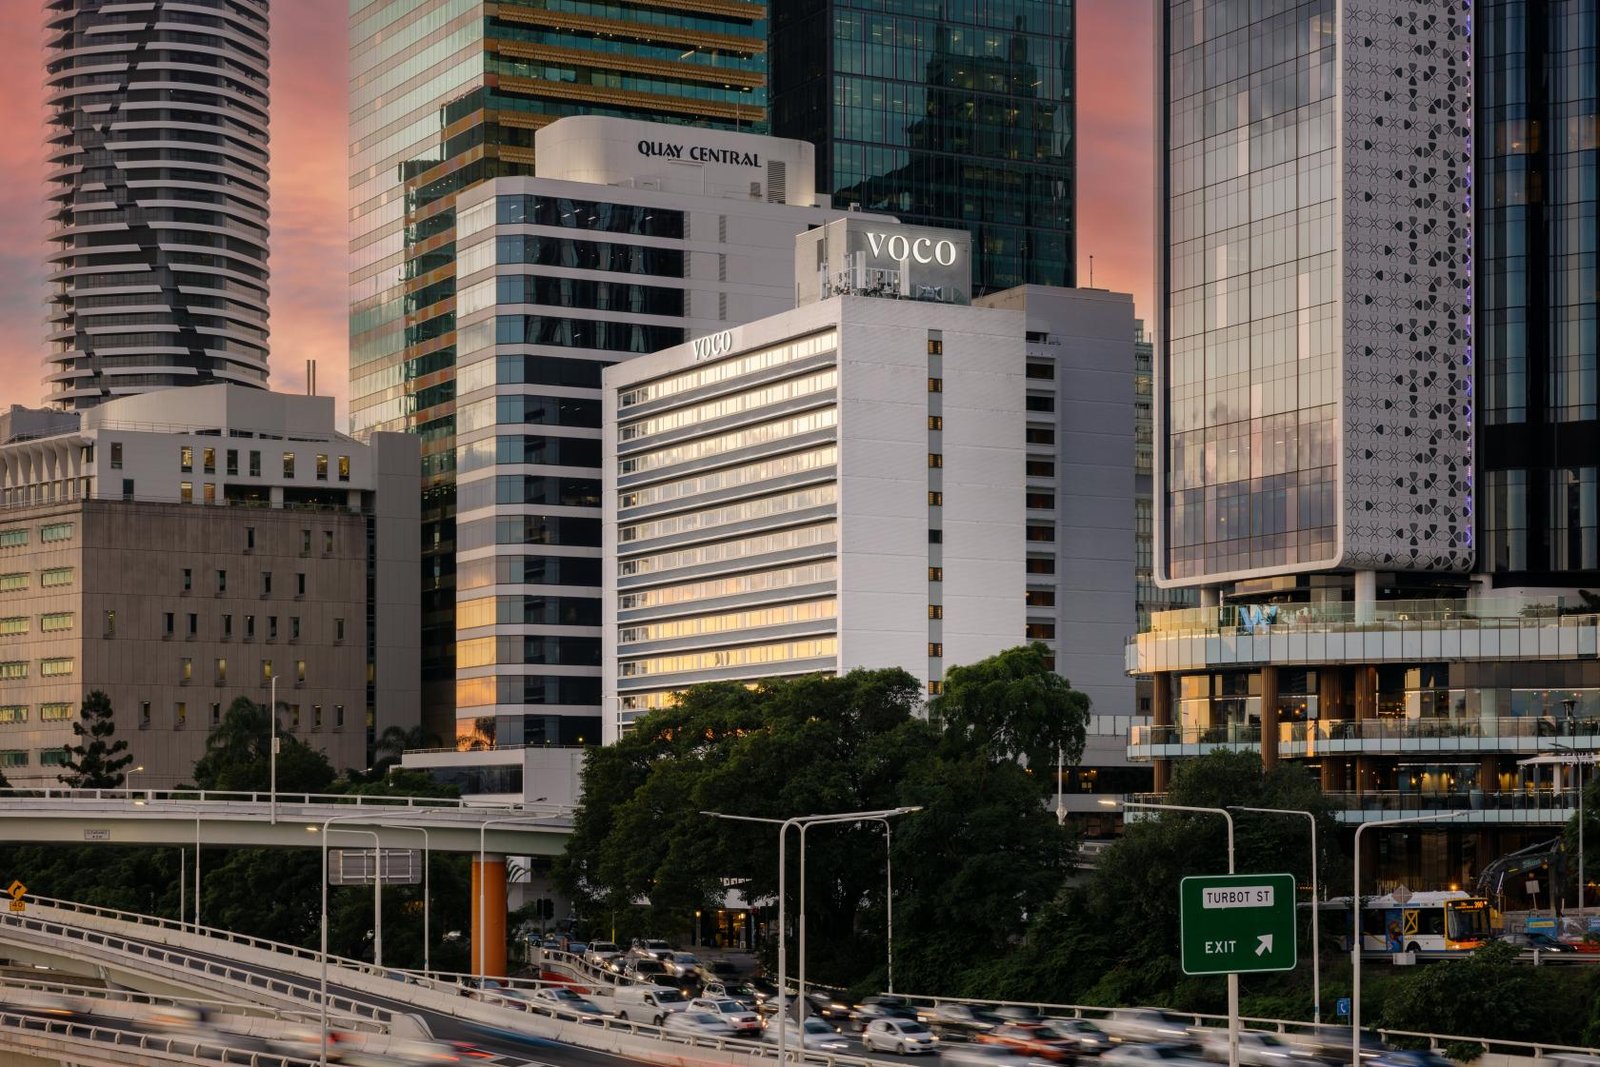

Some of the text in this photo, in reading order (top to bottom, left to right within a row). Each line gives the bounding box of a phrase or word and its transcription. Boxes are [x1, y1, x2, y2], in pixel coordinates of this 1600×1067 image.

[637, 140, 762, 168] QUAY CENTRAL
[1207, 890, 1270, 904] TURBOT ST
[12, 901, 23, 909] 40
[1205, 940, 1237, 954] EXIT
